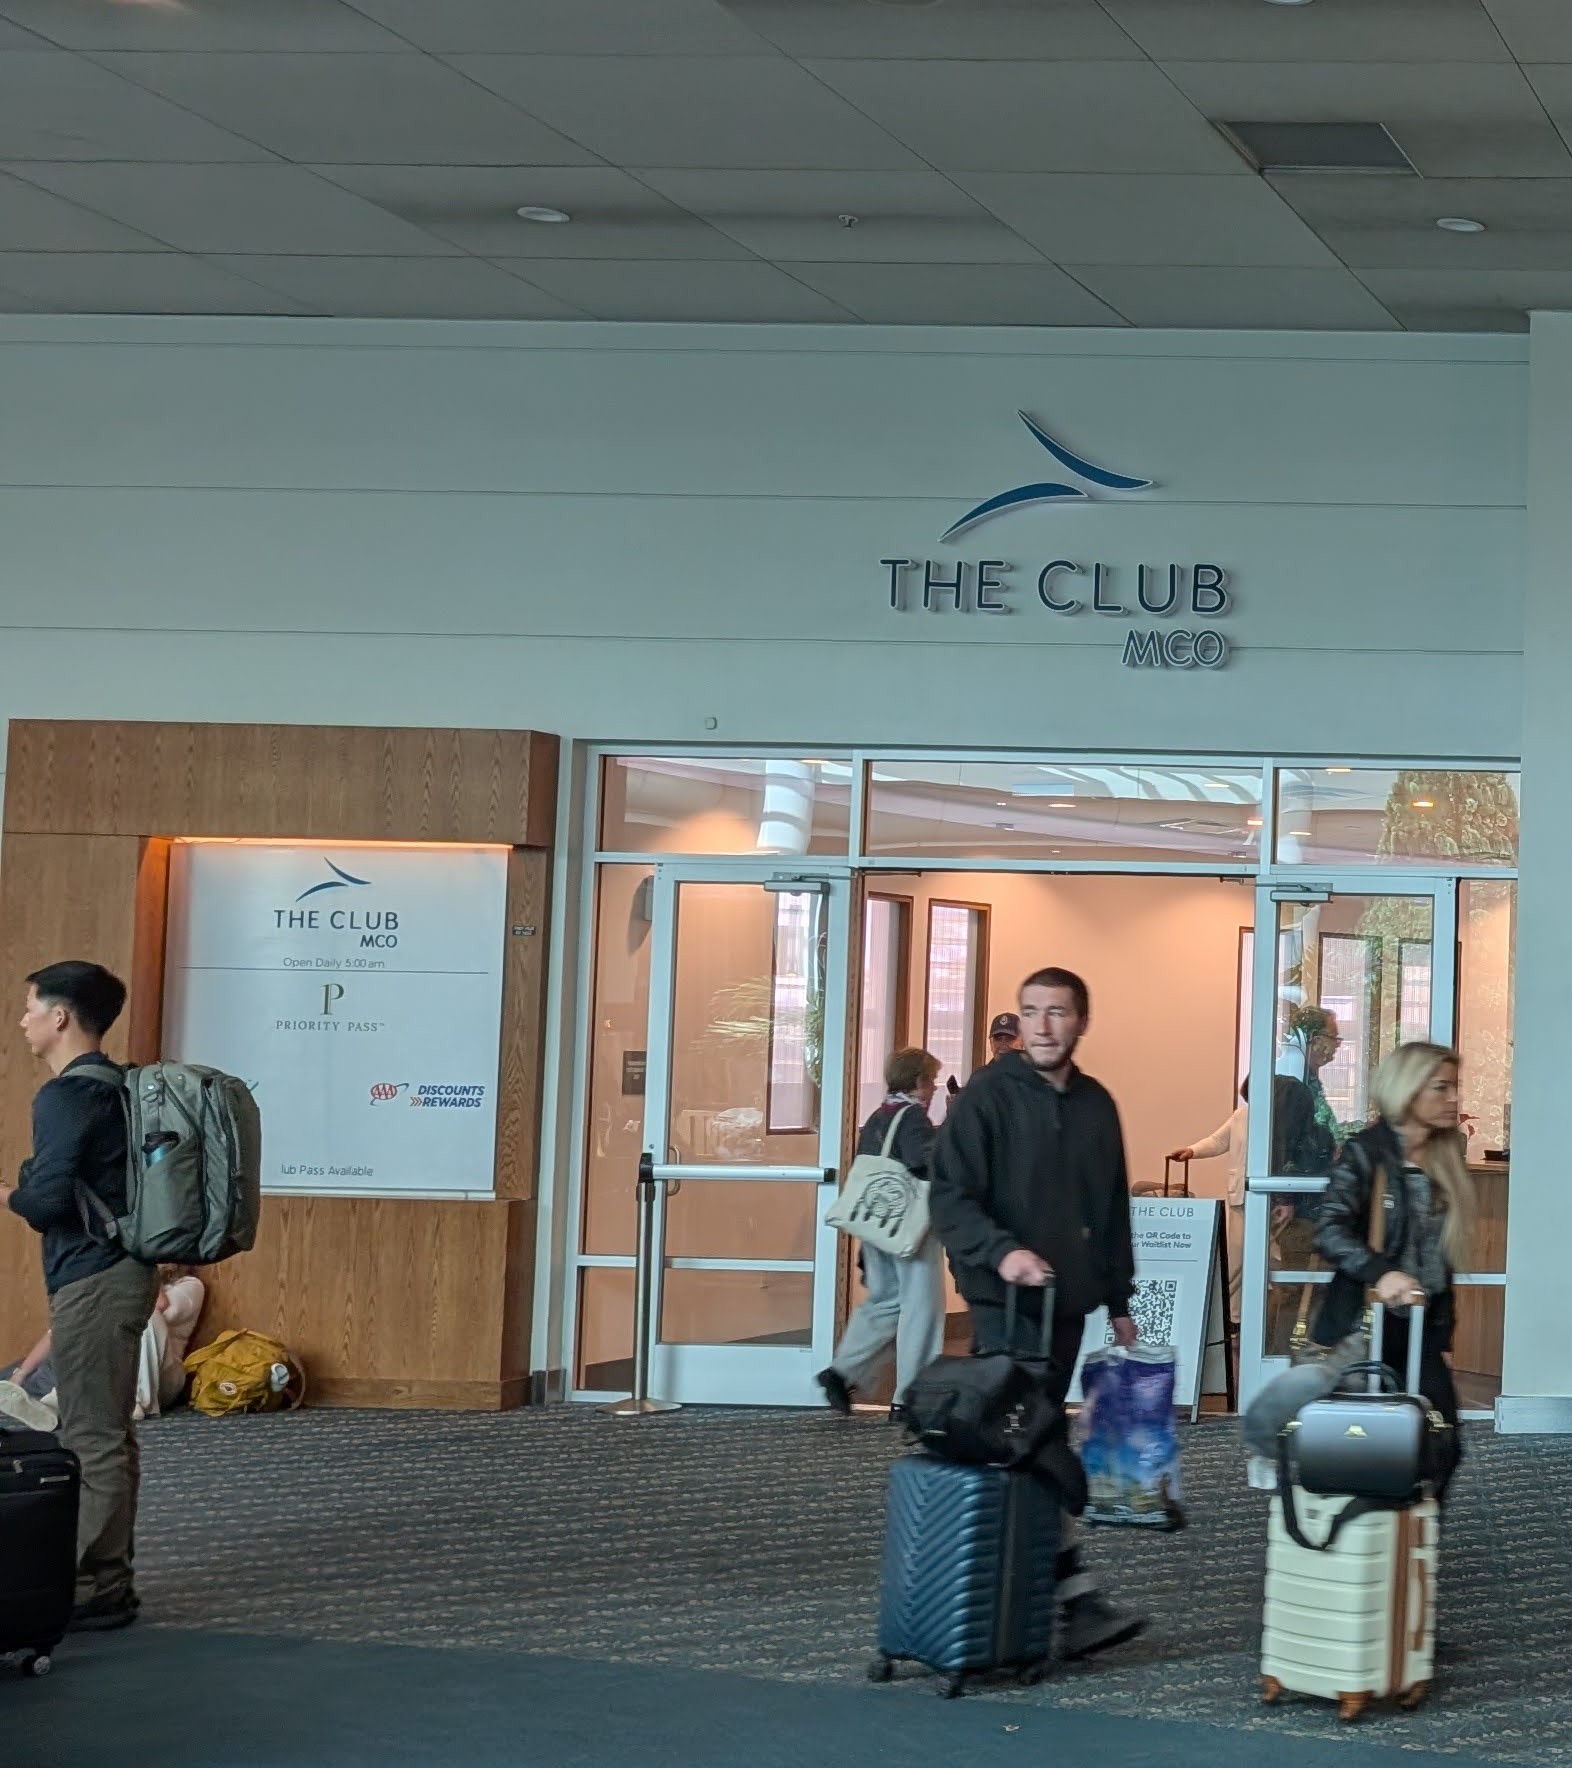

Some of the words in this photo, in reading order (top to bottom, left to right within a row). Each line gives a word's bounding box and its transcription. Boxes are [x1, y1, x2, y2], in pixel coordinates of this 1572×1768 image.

[879, 558, 1009, 612] THE
[1037, 559, 1229, 616] CLUB
[1121, 628, 1228, 668] MCO
[273, 909, 320, 929] THE
[329, 910, 399, 930] CLUB
[359, 934, 398, 948] MCO
[283, 957, 313, 968] Open
[315, 958, 342, 969] Daily
[276, 1020, 340, 1031] PRIORITY
[417, 1085, 485, 1096] DISCOUNTS
[421, 1097, 482, 1108] REWARDS
[281, 1164, 296, 1175] lub
[299, 1165, 325, 1176] Pass
[327, 1166, 374, 1176] Available
[1131, 1206, 1155, 1217] THE
[1159, 1206, 1194, 1217] CLUB
[1145, 1231, 1159, 1239] QR
[1160, 1232, 1181, 1240] Code
